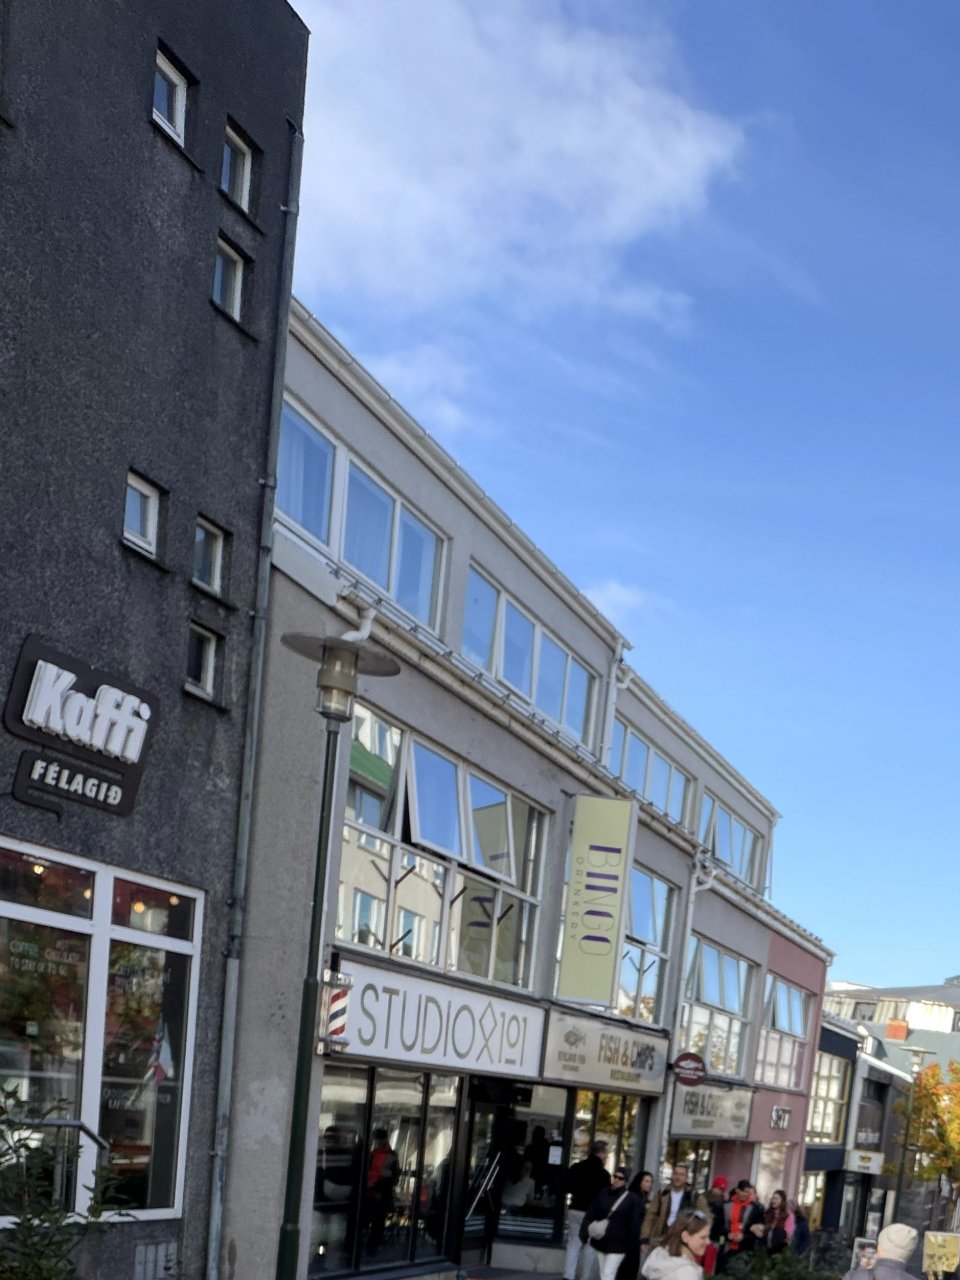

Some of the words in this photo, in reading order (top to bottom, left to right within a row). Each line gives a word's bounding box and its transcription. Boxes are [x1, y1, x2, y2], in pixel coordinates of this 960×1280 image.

[22, 659, 151, 765] Kaffi
[30, 759, 123, 805] FÉLAGIÐ
[578, 844, 622, 957] BINGO
[358, 983, 476, 1060] STUDIO
[598, 1032, 621, 1065] FISH
[621, 1039, 630, 1068] &
[631, 1040, 657, 1072] CHIPS
